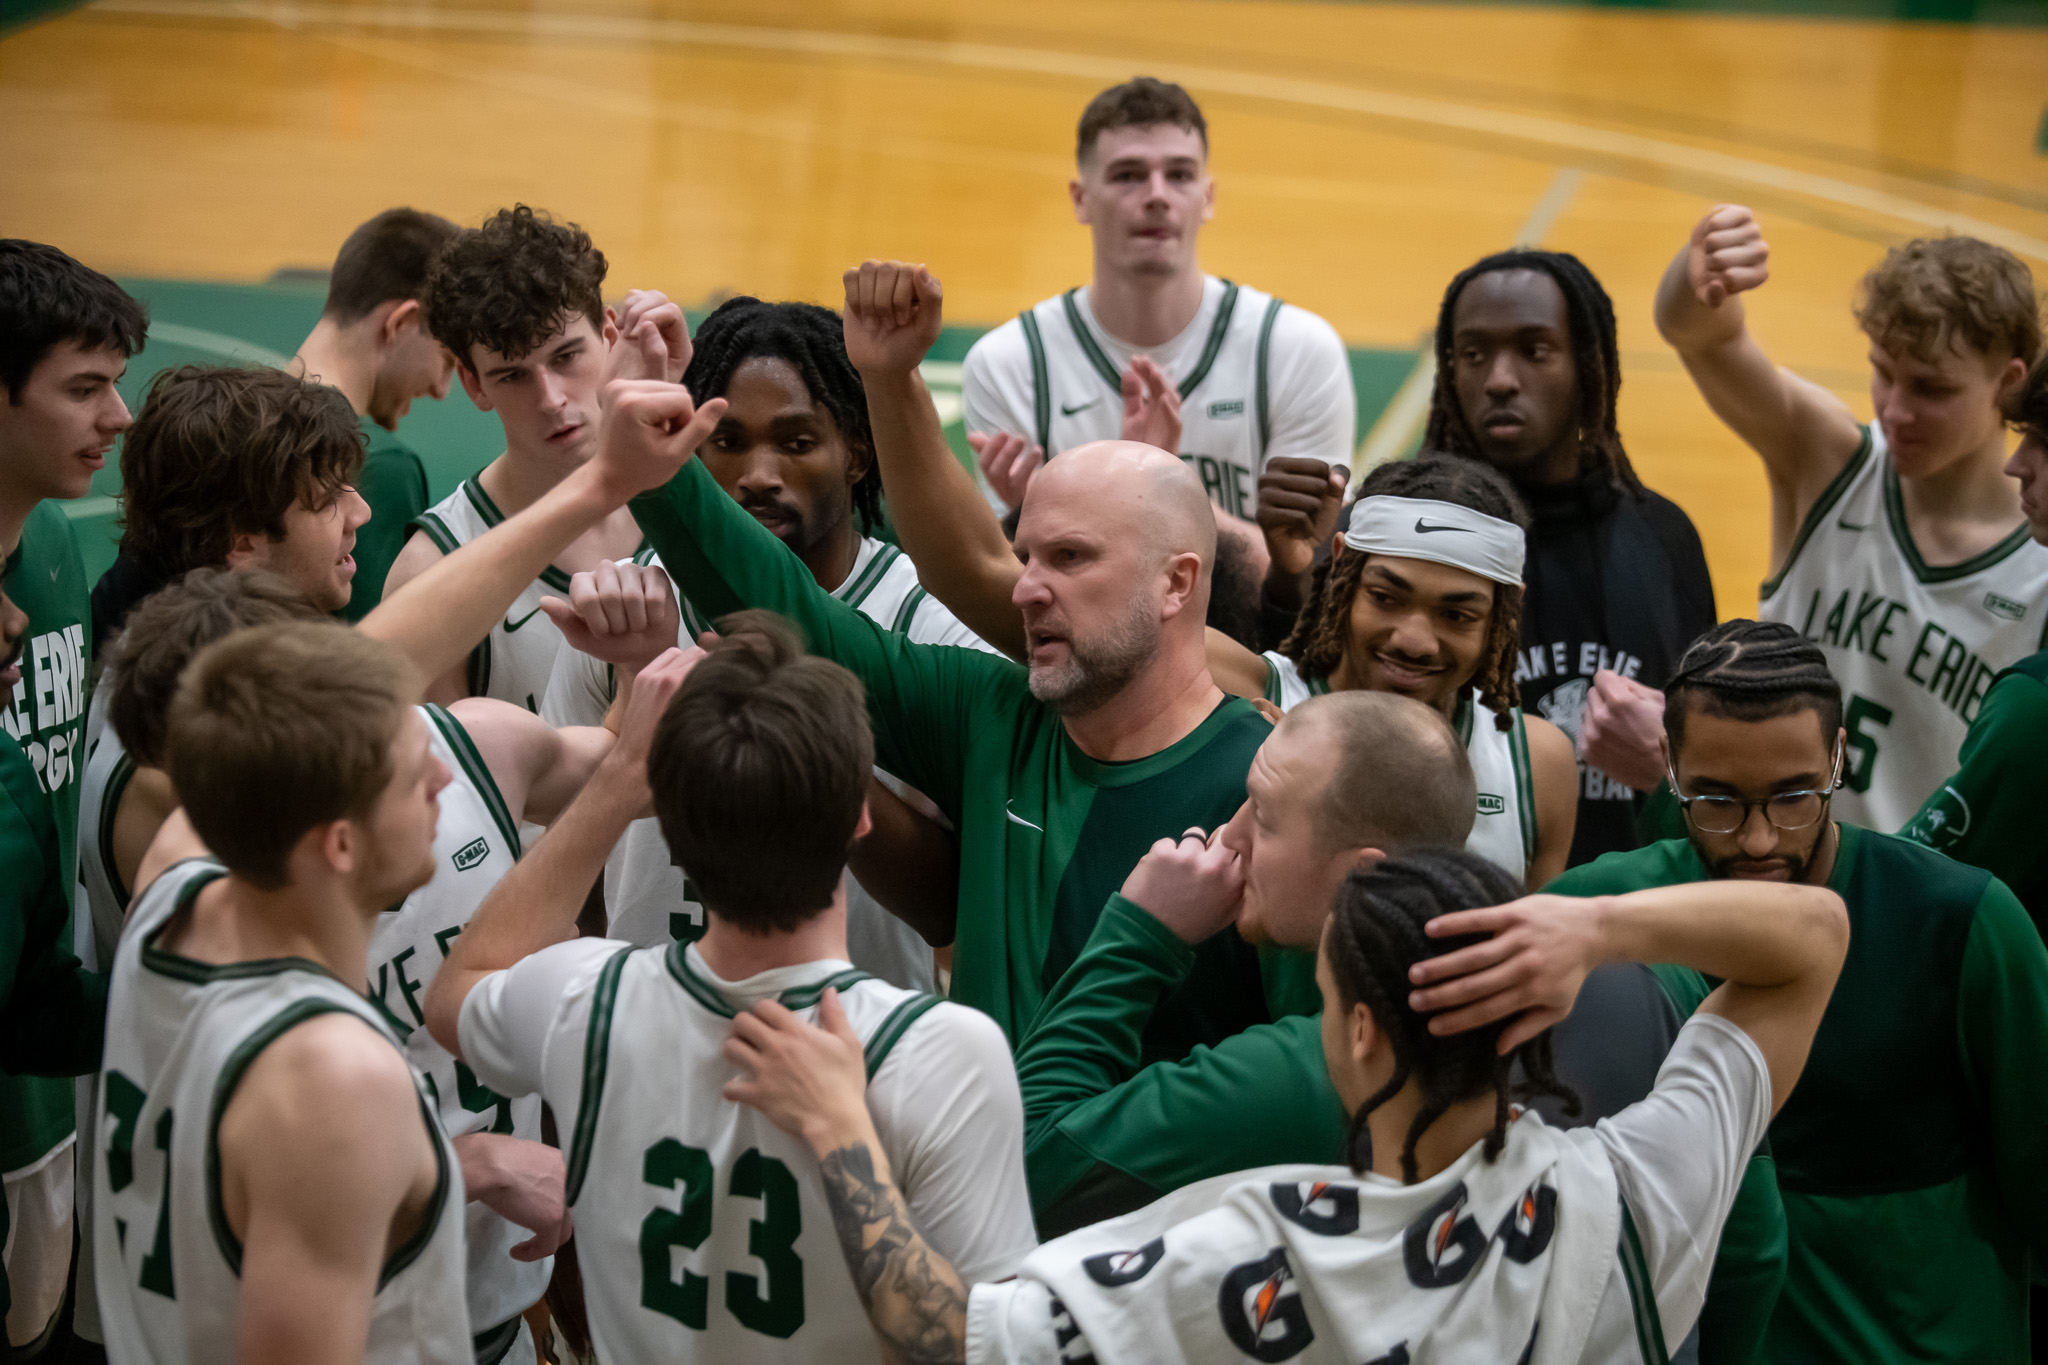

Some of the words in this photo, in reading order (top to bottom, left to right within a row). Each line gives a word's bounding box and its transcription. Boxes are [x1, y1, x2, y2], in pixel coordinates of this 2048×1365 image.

[1179, 454, 1257, 523] RIE
[32, 623, 85, 731] ERIE
[1513, 641, 1568, 683] AKE
[1803, 589, 1908, 663] LAKE
[1904, 621, 1996, 727] ERIE
[1478, 798, 1501, 809] MAC
[457, 841, 486, 866] G-MAC
[639, 1136, 806, 1340] 23
[1217, 1246, 1316, 1364] G
